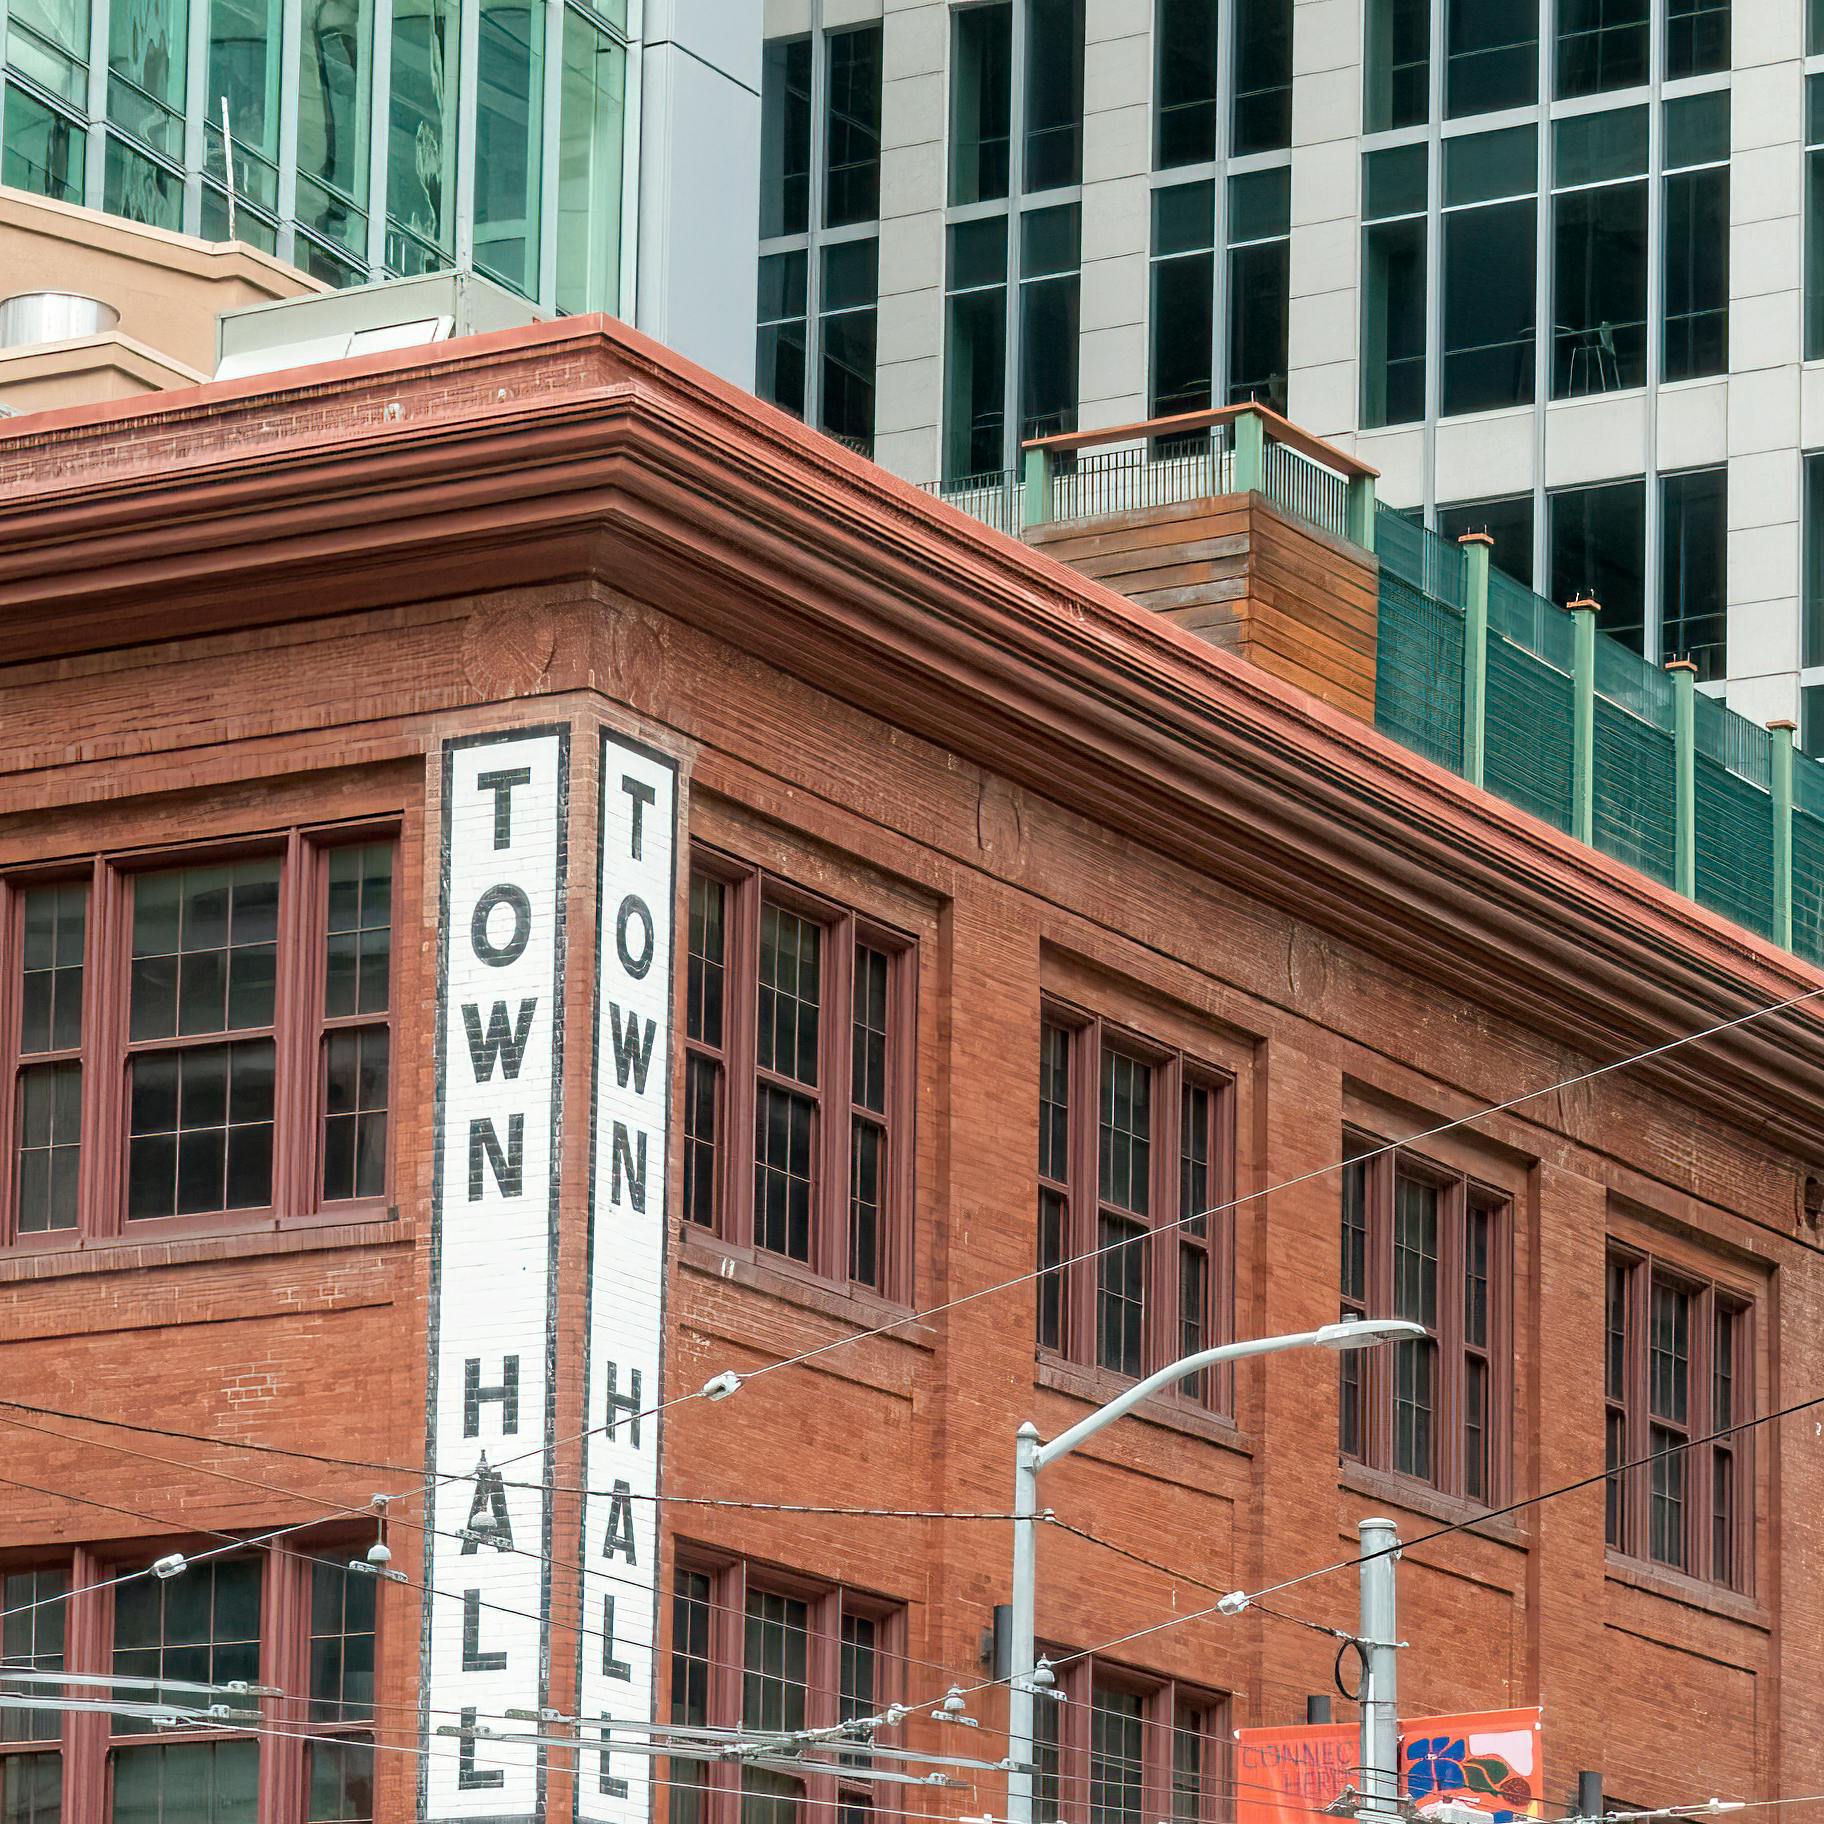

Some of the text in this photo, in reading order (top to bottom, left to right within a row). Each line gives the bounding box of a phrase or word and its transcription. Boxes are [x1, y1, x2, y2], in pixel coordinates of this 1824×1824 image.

[459, 767, 538, 1791] TOWN HALL
[599, 775, 657, 1799] TOWN HALL
[1244, 1741, 1353, 1768] CONNEC
